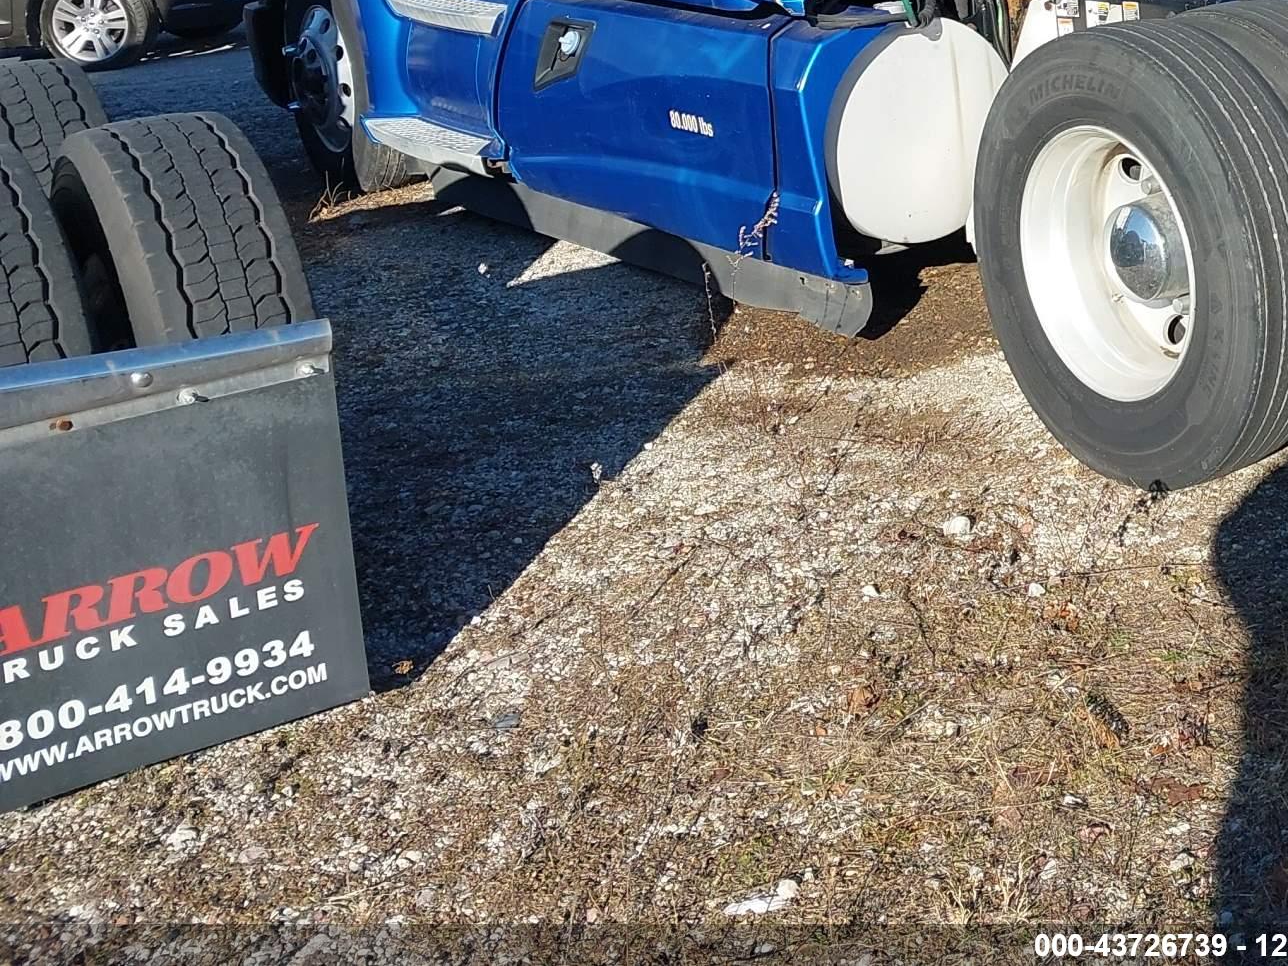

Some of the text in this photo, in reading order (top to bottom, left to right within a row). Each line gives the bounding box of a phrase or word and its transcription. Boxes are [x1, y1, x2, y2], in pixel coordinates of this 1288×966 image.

[1027, 72, 1123, 107] MICHELIN
[698, 116, 714, 137] lbs
[163, 579, 306, 636] SALES
[0, 629, 315, 752] 800-414-9934
